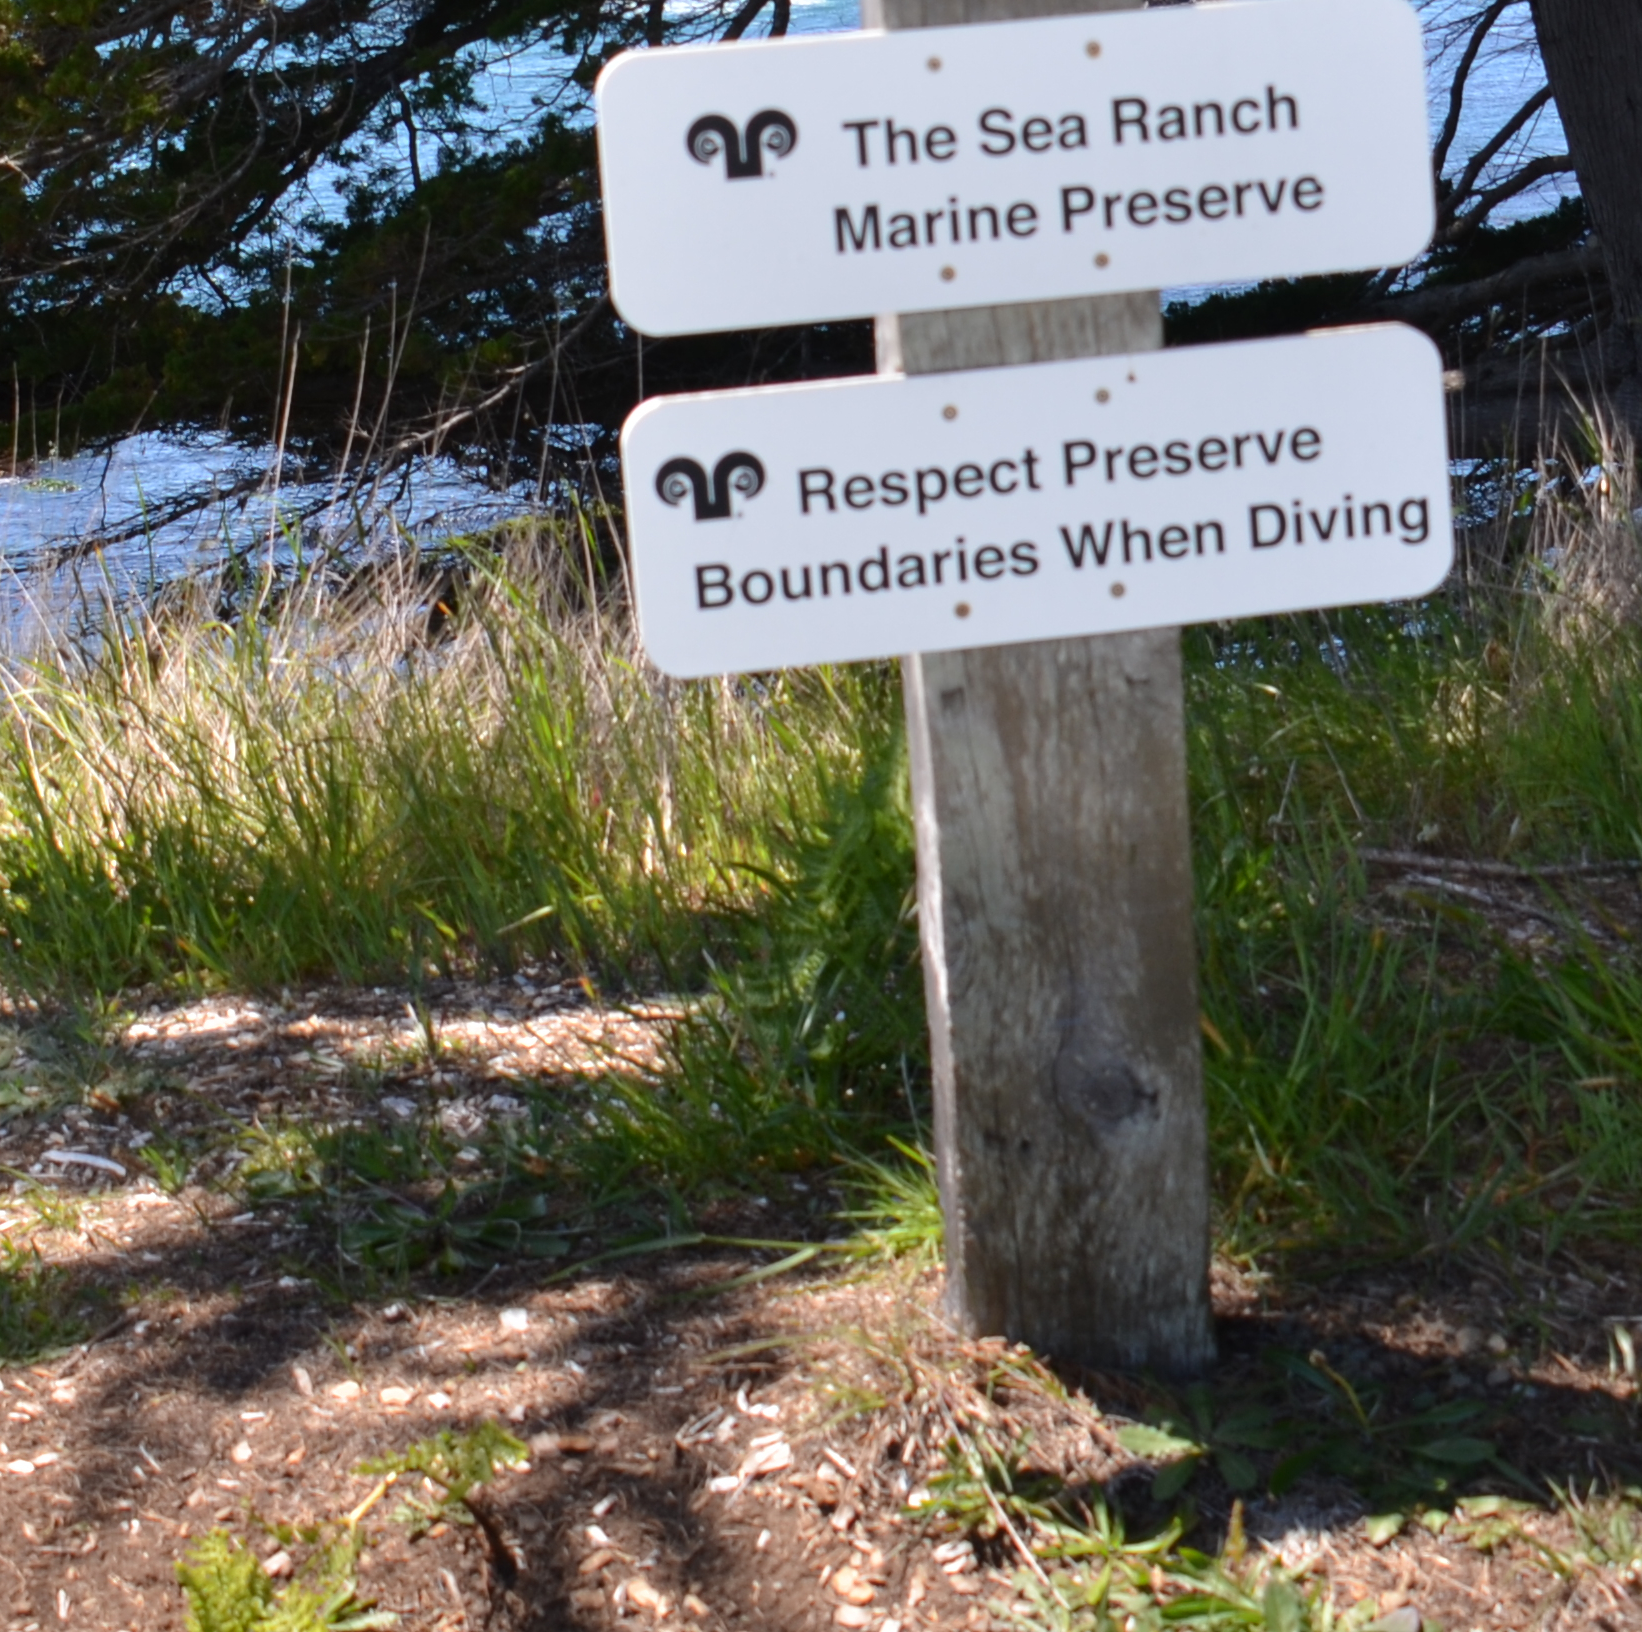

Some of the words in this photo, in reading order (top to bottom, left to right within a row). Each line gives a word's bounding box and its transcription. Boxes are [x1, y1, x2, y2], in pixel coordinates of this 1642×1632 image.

[841, 119, 957, 168] The
[978, 108, 1089, 156] Sea
[1111, 85, 1299, 145] Ranch
[833, 200, 1039, 254] Marine
[1060, 176, 1325, 233] Preserve
[797, 449, 1041, 516] Respect
[1062, 427, 1323, 487] Preserve
[694, 538, 1040, 611] Boundaries
[1059, 518, 1226, 569] When
[1248, 495, 1431, 550] Diving
